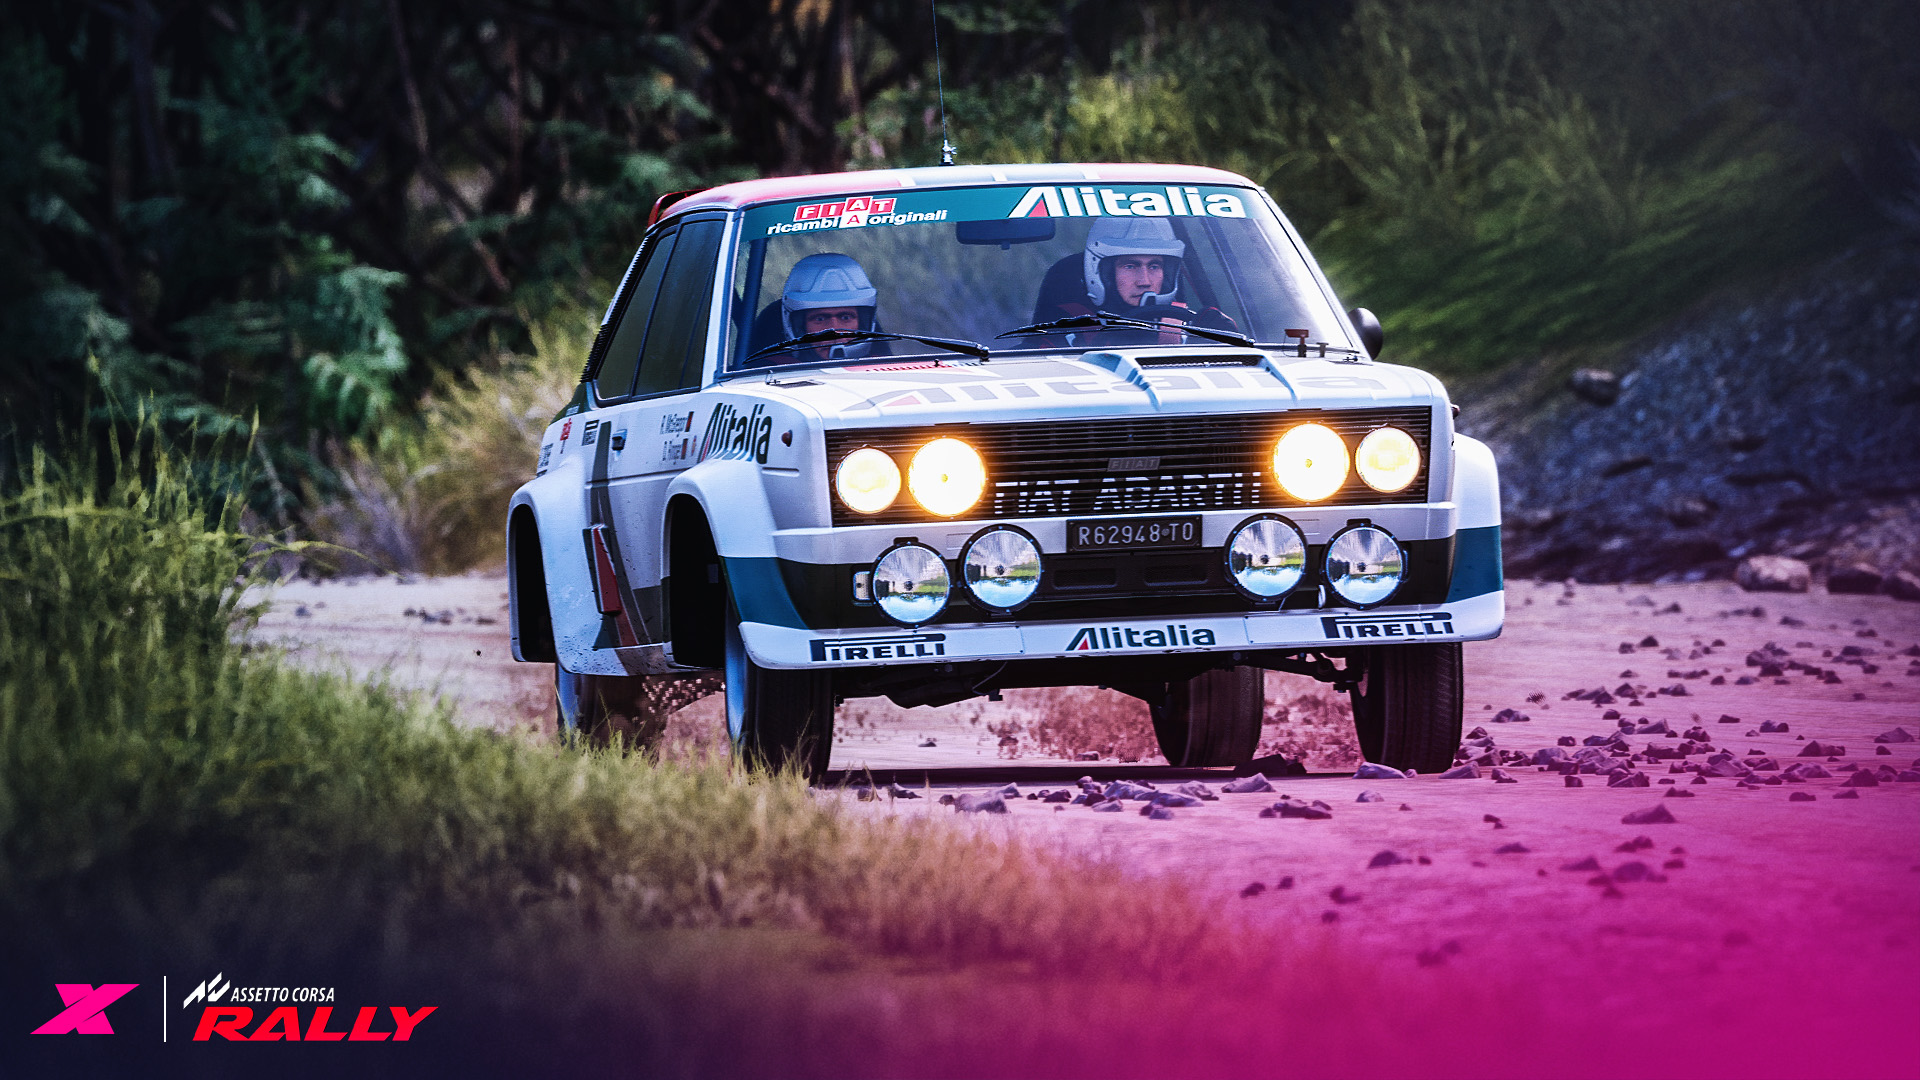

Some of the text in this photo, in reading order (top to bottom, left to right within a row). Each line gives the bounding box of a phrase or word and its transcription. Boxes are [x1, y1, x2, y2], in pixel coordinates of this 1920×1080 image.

[799, 197, 892, 220] FIAT
[1007, 186, 1247, 218] Alitalia
[767, 216, 839, 235] ricambi
[867, 209, 948, 226] originali
[840, 369, 1388, 412] Alitalia
[697, 402, 772, 465] Alitalia
[1109, 457, 1158, 470] FIAT
[994, 471, 1262, 515] FIAT ABARTH
[1065, 624, 1217, 652] Alitalia
[1319, 611, 1455, 639] PIRELLI
[809, 632, 947, 662] PIRELLI
